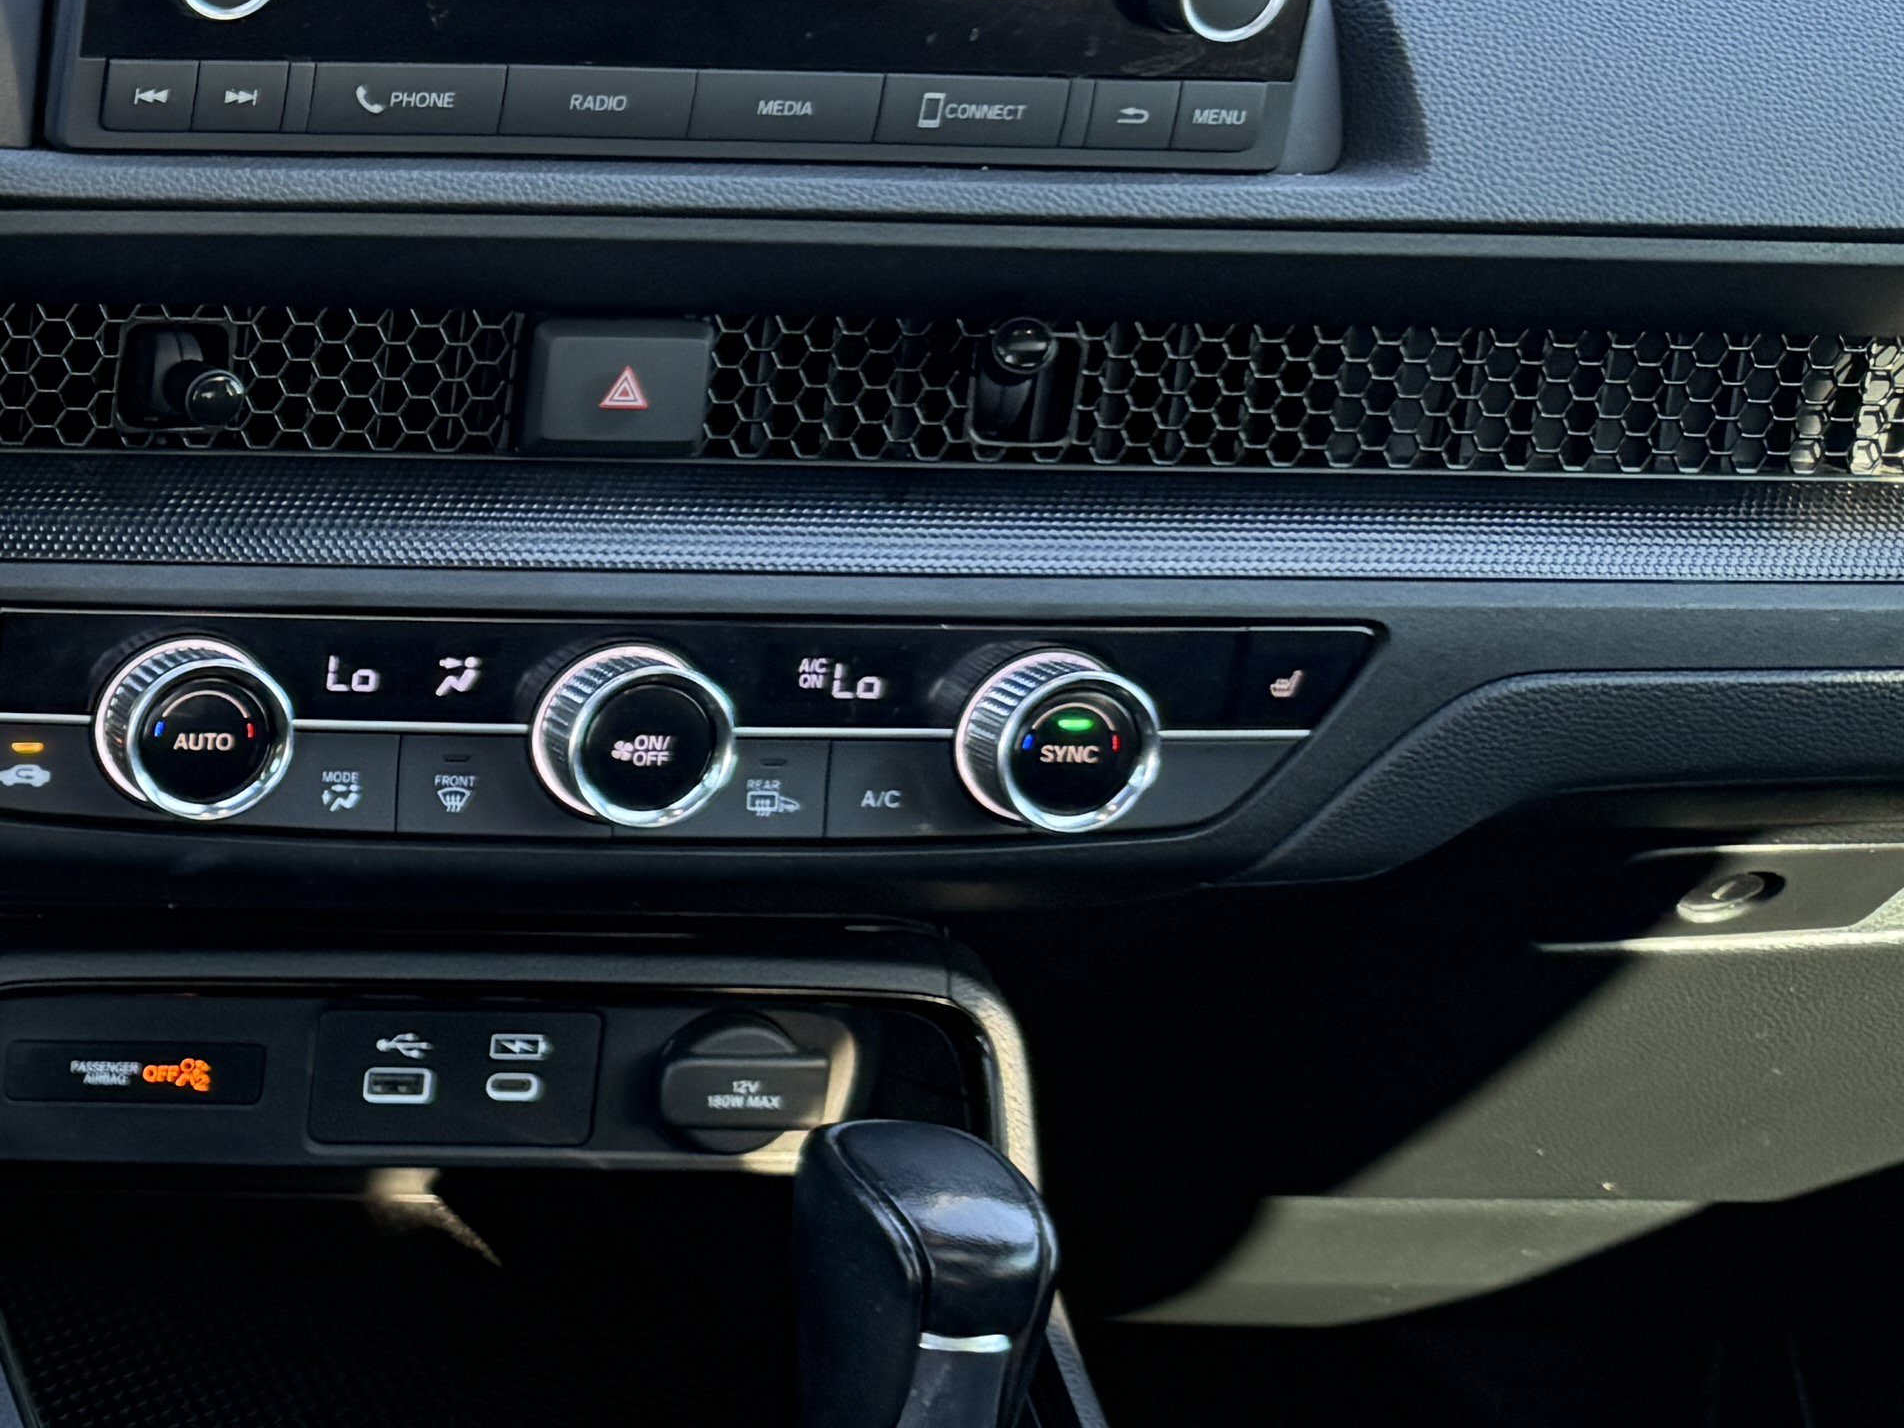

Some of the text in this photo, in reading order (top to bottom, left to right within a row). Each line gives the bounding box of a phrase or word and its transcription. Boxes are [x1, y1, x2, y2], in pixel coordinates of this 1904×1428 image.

[389, 91, 457, 110] PHONE
[569, 93, 628, 112] RADIO
[756, 99, 814, 117] MEDIA
[943, 102, 1028, 121] CONNECT
[1192, 108, 1247, 126] MENU
[798, 657, 828, 673] A/C
[798, 674, 824, 689] ON
[173, 732, 235, 751] AUTO
[634, 734, 671, 750] ON/
[633, 751, 670, 767] OFF
[1039, 744, 1100, 764] SYNC
[321, 771, 360, 783] MODE
[434, 774, 477, 787] FRONT
[746, 779, 782, 790] REAR
[860, 789, 902, 808] A/C
[70, 1060, 142, 1074] PASSENGER
[143, 1064, 181, 1083] OFF
[83, 1073, 130, 1086] AIRBAG
[732, 1080, 761, 1093] 12V
[745, 1095, 782, 1110] MAX
